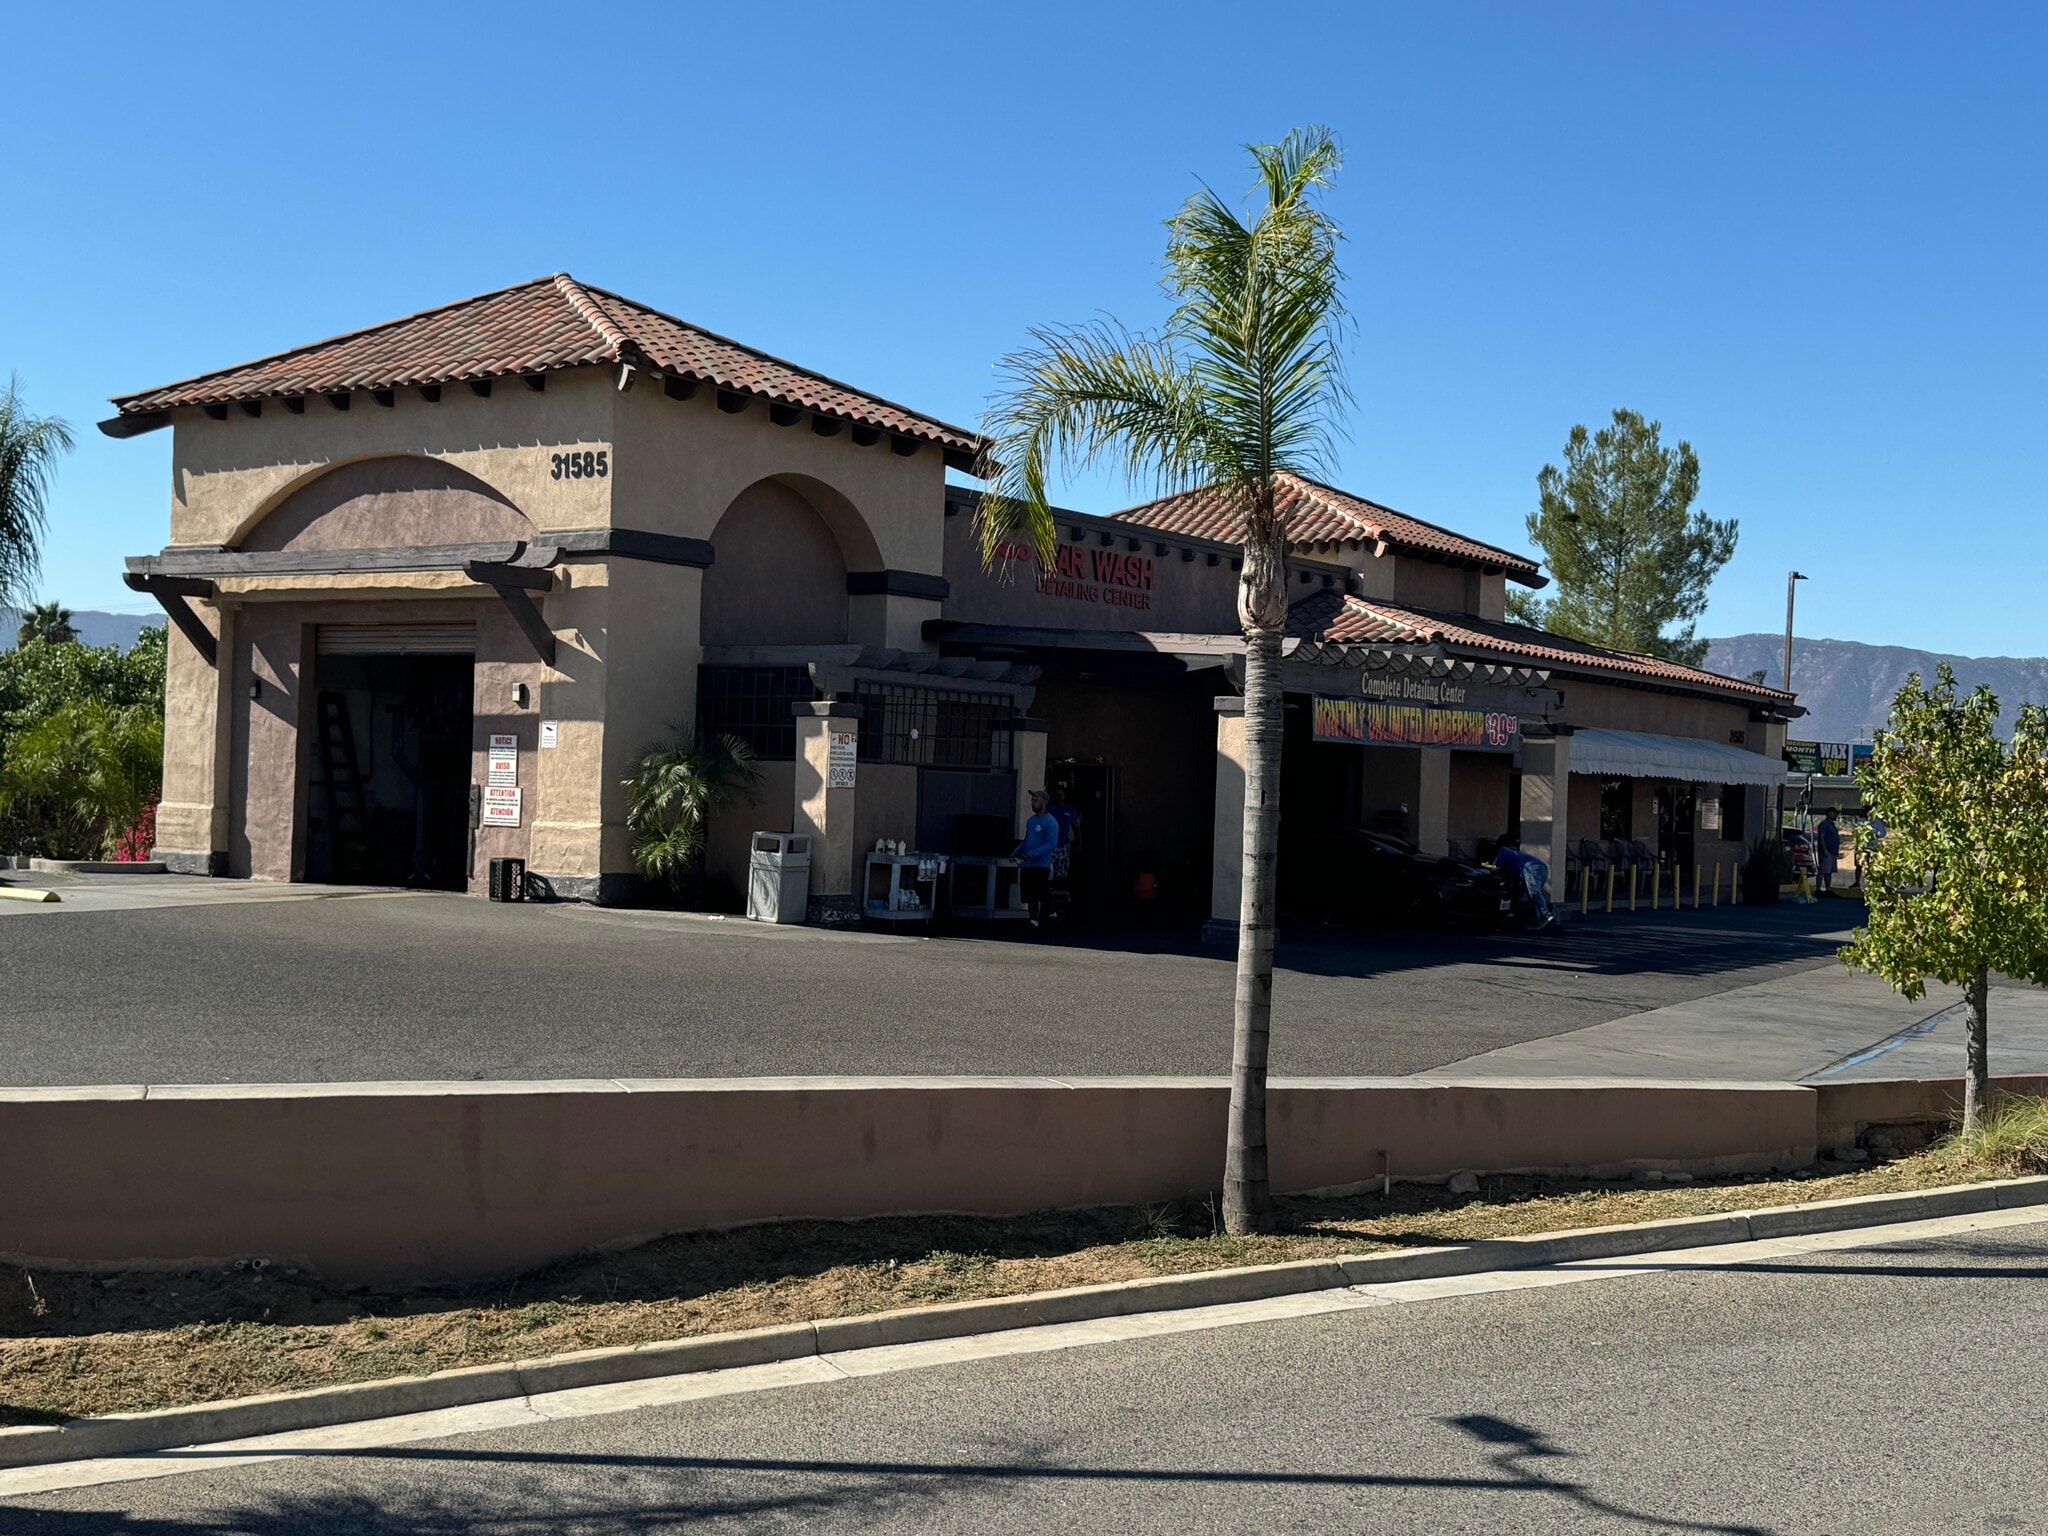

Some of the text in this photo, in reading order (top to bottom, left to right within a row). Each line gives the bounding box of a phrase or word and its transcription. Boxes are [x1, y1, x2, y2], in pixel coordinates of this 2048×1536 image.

[551, 451, 608, 481] 31585
[1037, 544, 1087, 578] AR
[1093, 549, 1155, 590] WASH
[1103, 587, 1151, 609] CENTER
[1362, 672, 1466, 704] Complete Detailing Center
[1315, 698, 1366, 739] MONTHLY
[1368, 703, 1422, 744] UNLIMITED
[1425, 708, 1485, 746] MEMBERSHIP
[838, 734, 849, 744] NO
[1820, 743, 1847, 759] WAX
[490, 789, 515, 797] ATTENTION
